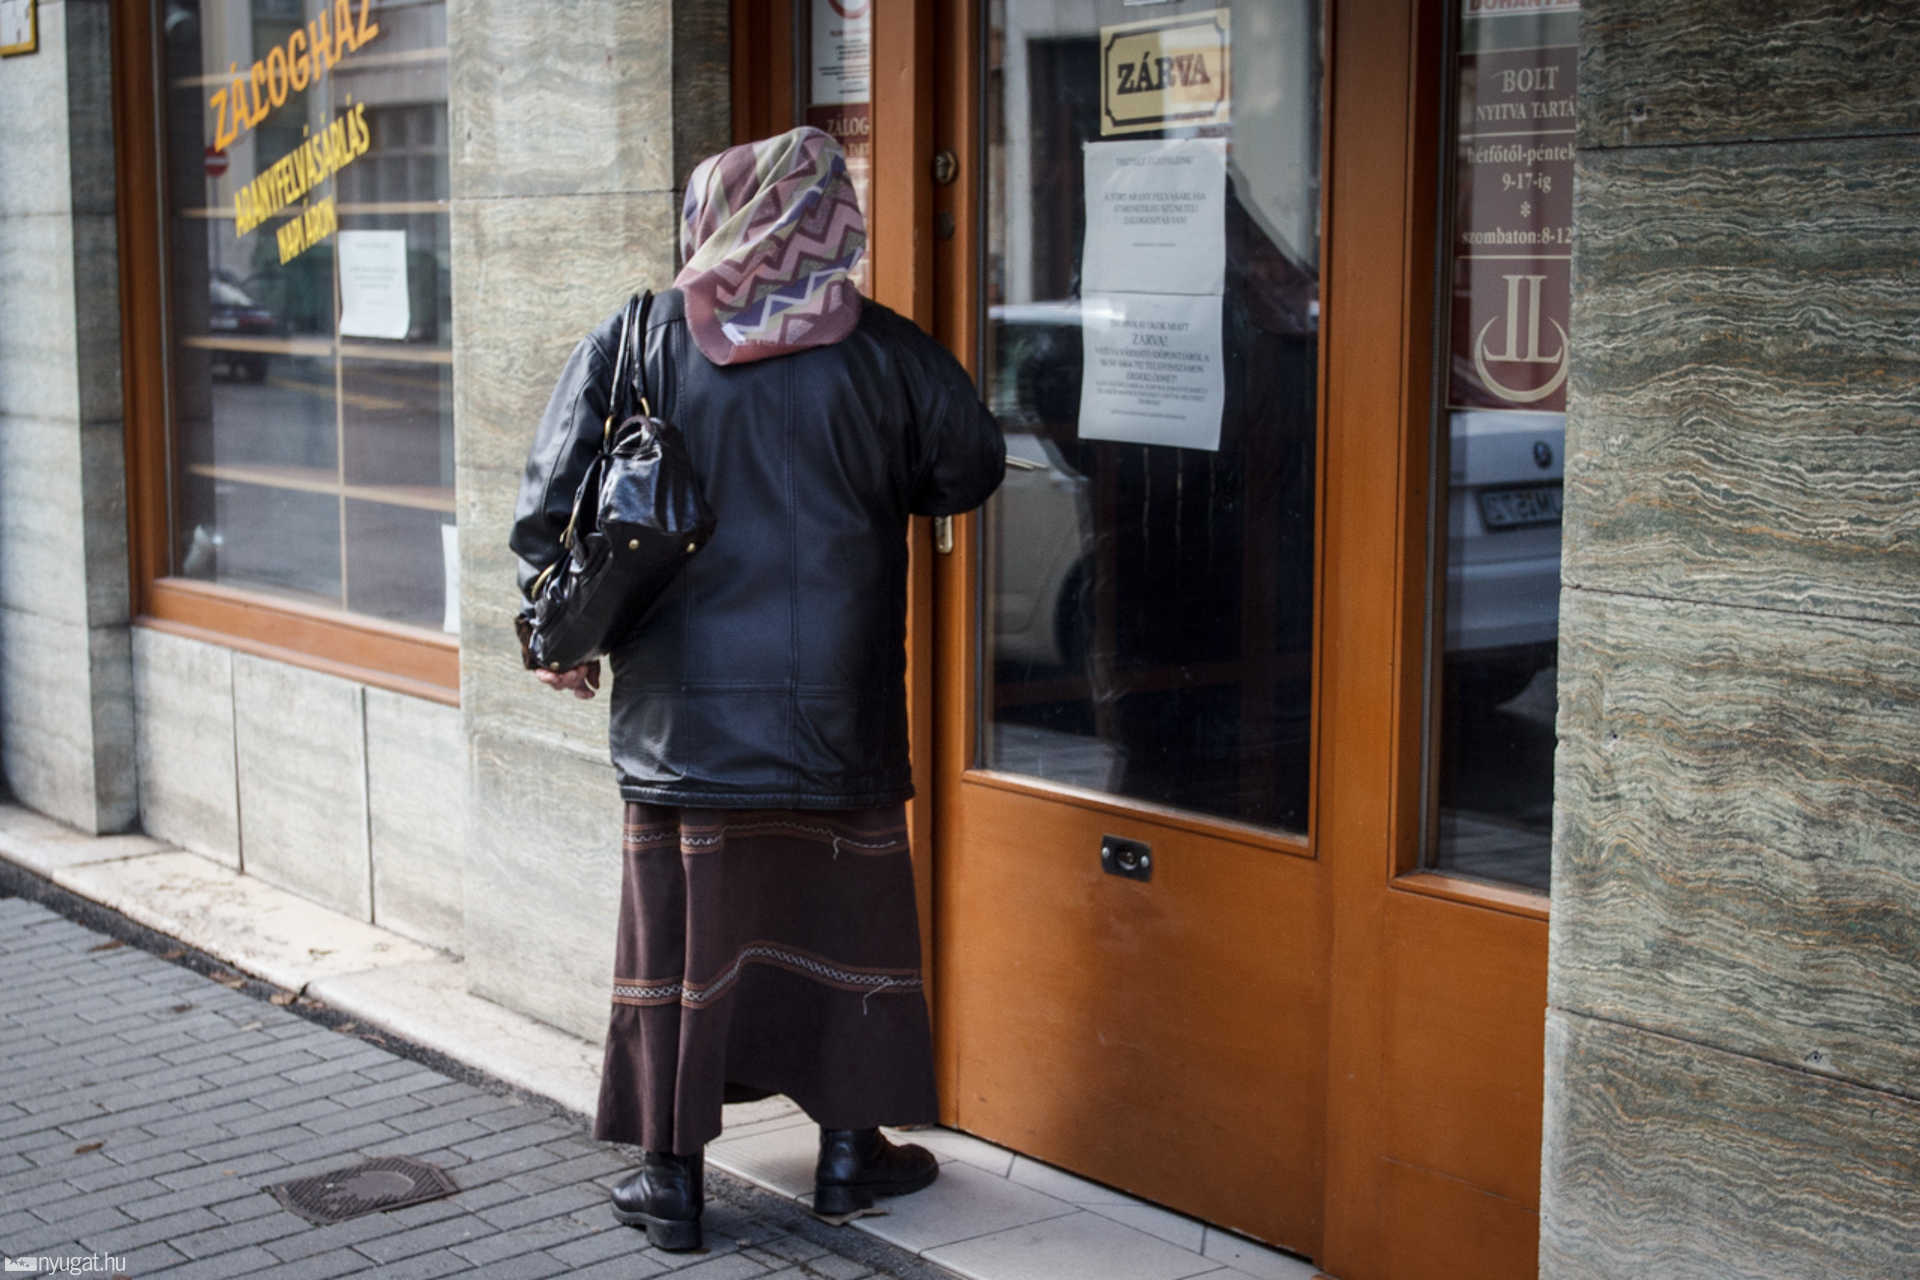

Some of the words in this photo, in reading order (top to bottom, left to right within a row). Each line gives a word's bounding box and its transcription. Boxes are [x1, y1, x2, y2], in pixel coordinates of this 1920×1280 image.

[1116, 51, 1211, 95] ZÁRVA
[1501, 66, 1559, 93] BOLT
[1476, 103, 1527, 121] NYITVA
[1502, 172, 1552, 193] 9-17-ig
